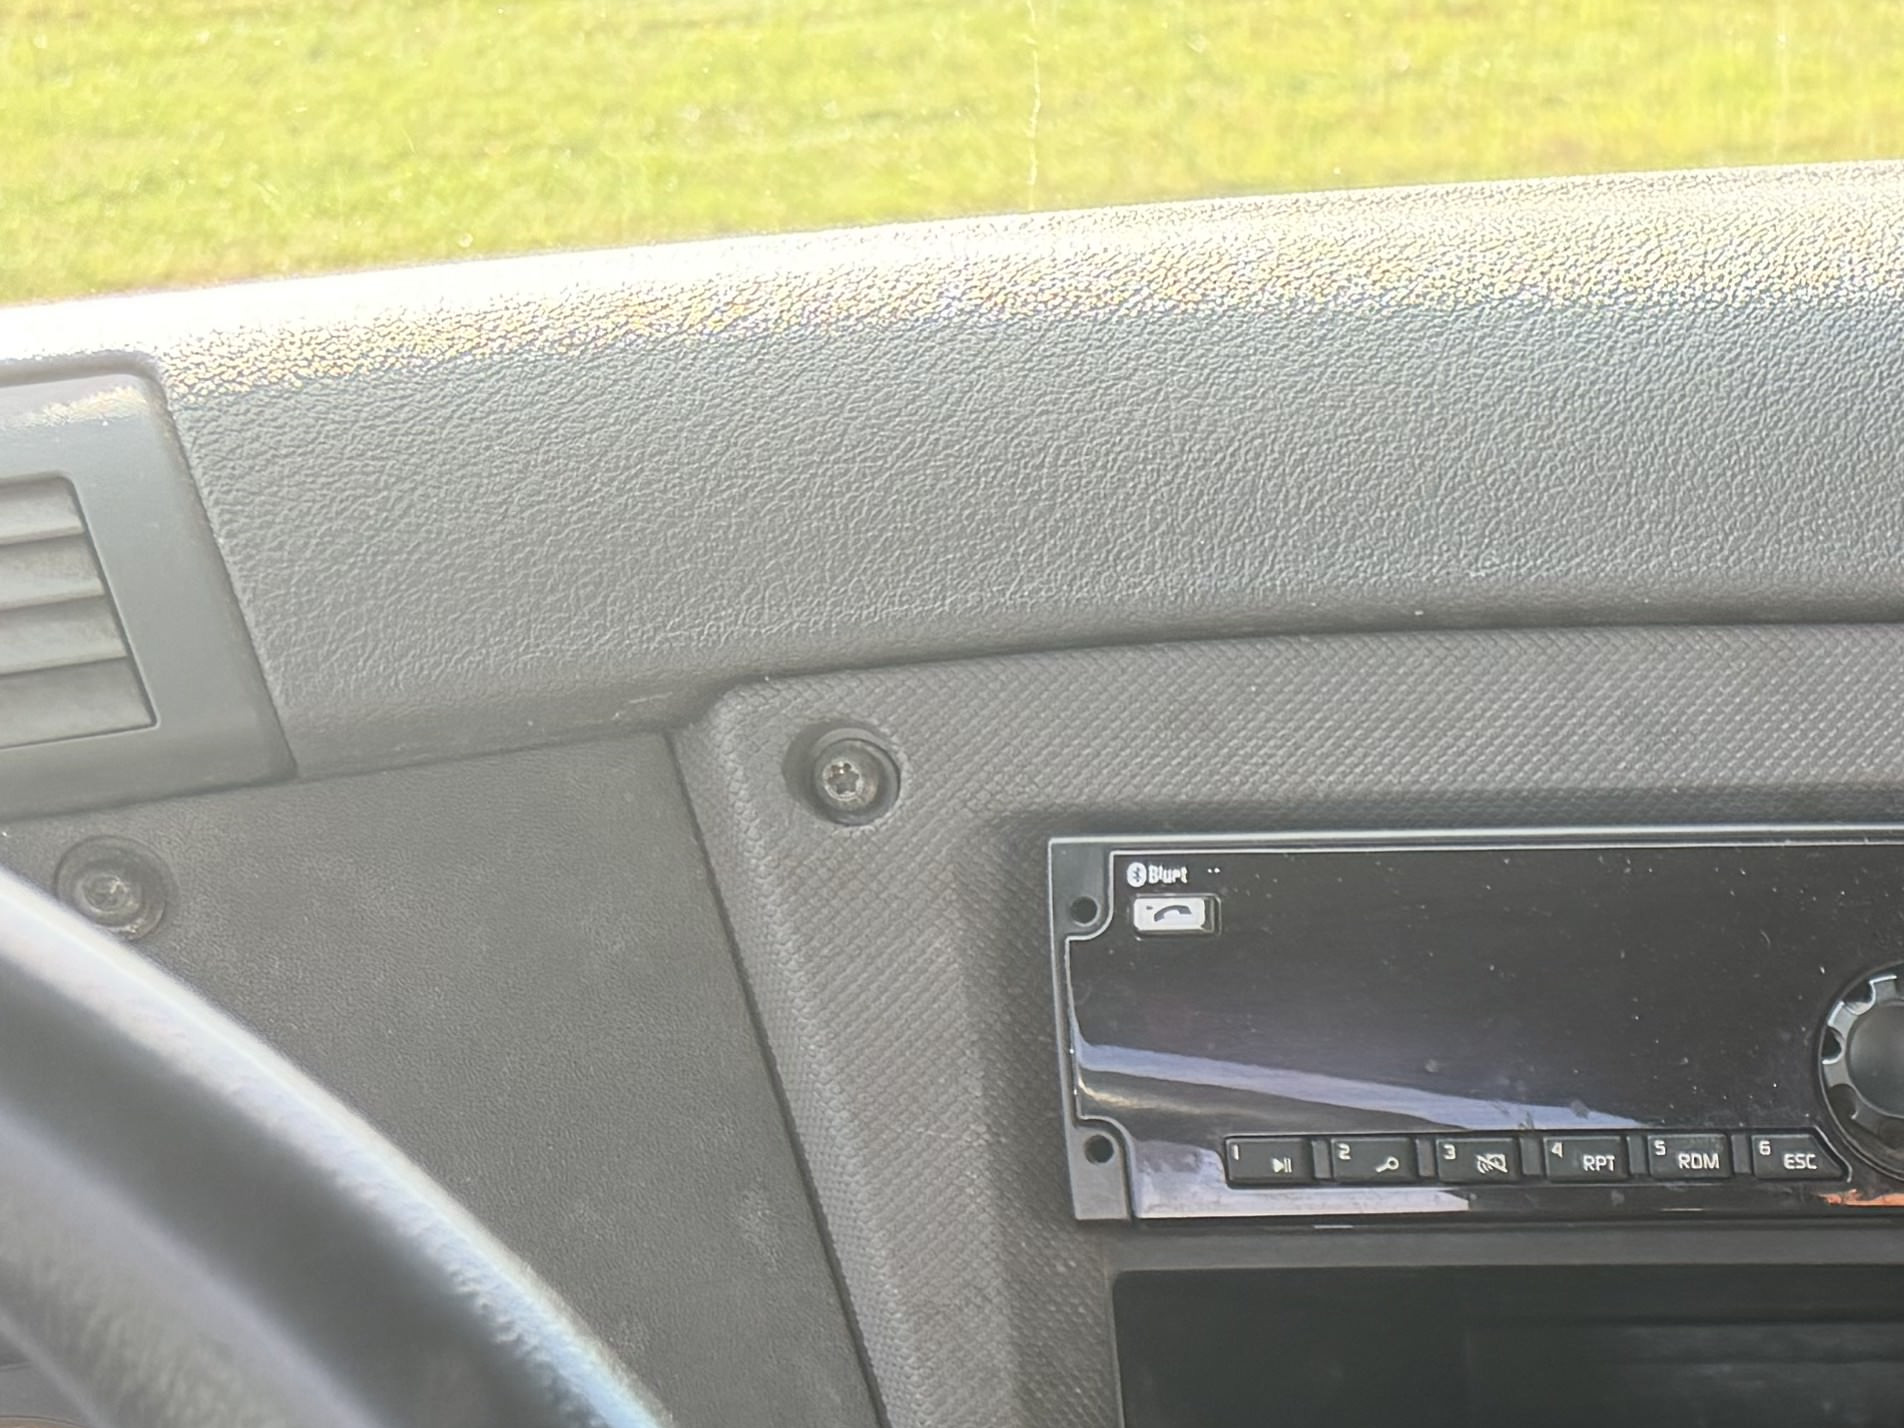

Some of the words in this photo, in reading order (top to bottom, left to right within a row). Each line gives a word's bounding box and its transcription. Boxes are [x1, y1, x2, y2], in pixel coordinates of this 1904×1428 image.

[1149, 864, 1188, 884] Blurt
[1233, 1144, 1239, 1160] 1
[1335, 1143, 1351, 1160] 2
[1443, 1143, 1456, 1159] 3
[1551, 1141, 1563, 1157] 4
[1654, 1140, 1666, 1156] 5
[1759, 1140, 1771, 1156] 6
[1583, 1155, 1615, 1172] RPT
[1679, 1153, 1720, 1170] RDM
[1783, 1153, 1817, 1170] ESC
